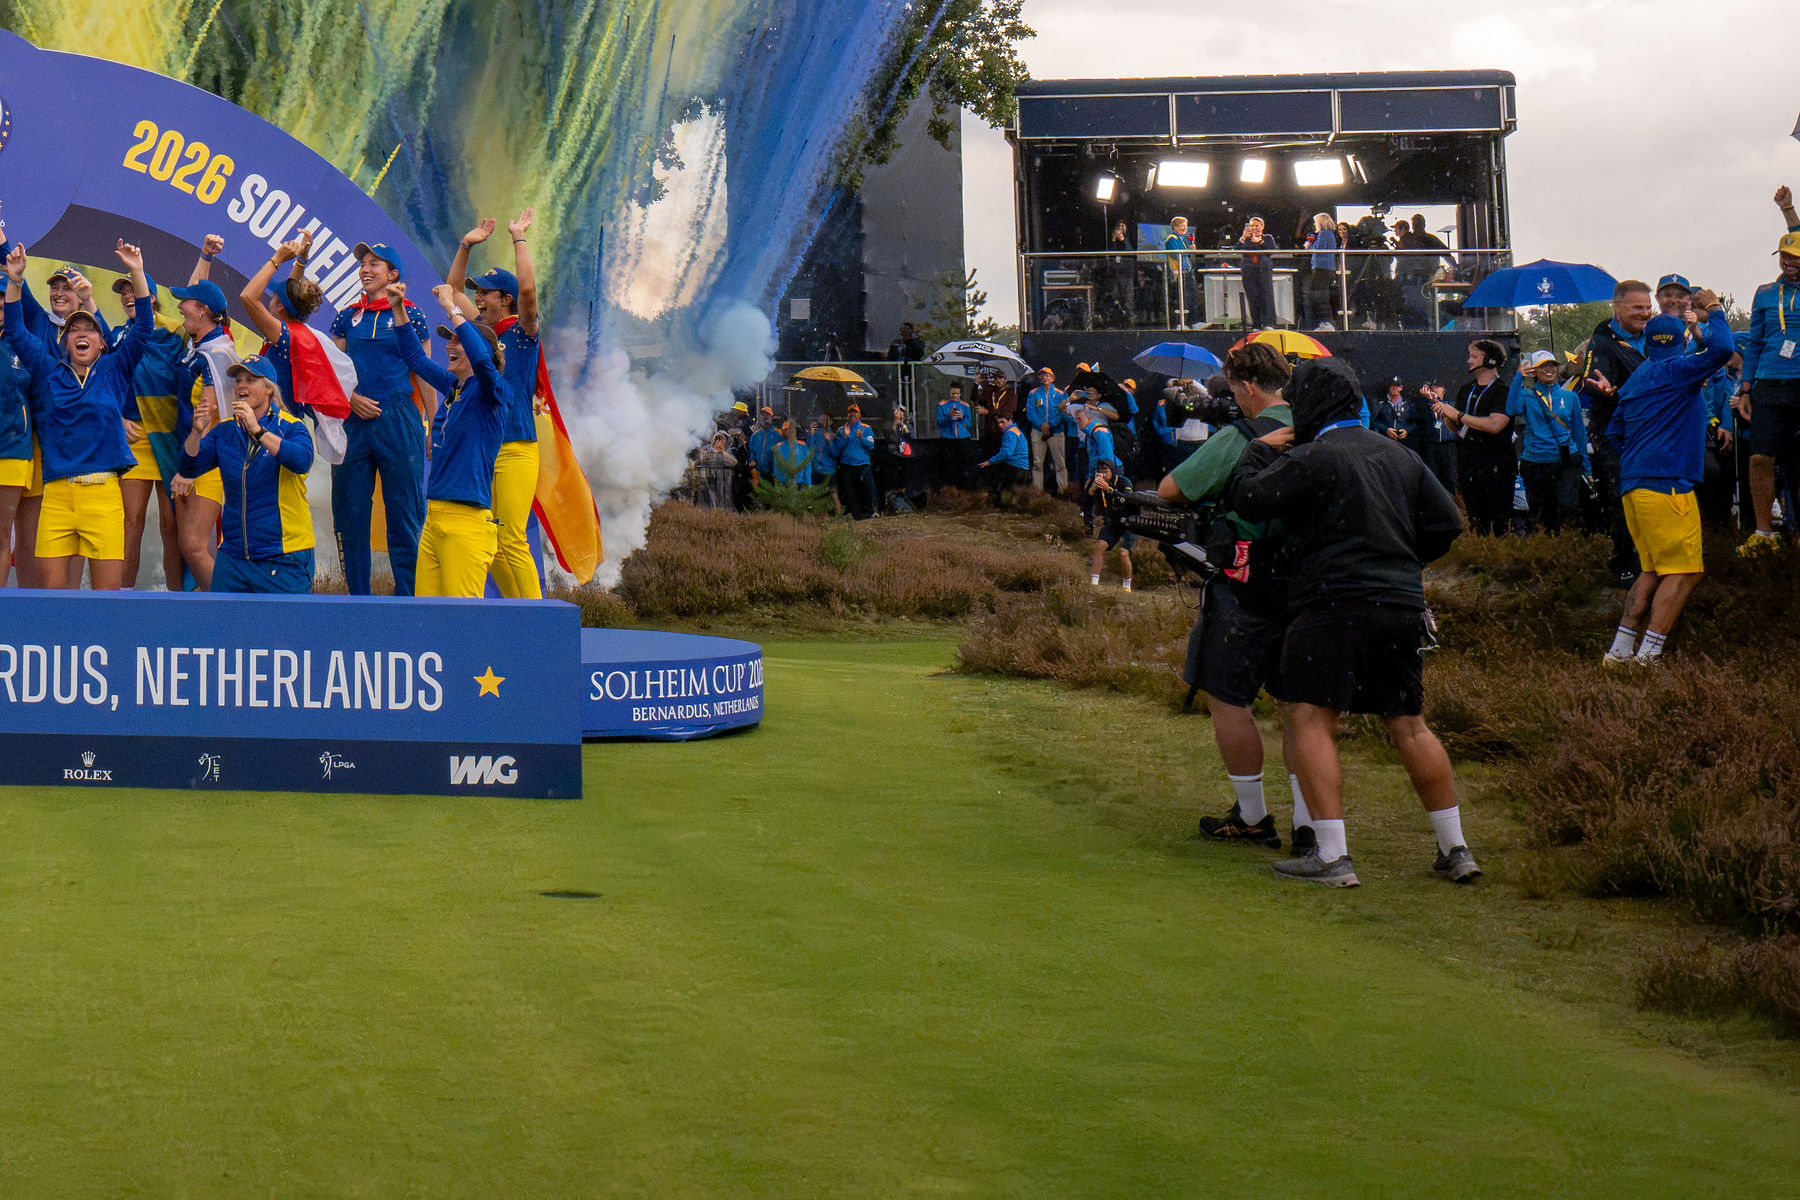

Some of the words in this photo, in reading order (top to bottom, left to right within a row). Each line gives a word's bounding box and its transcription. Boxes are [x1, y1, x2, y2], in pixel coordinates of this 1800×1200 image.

[123, 120, 235, 204] 2026
[136, 646, 443, 712] NETHERLANDS
[590, 668, 710, 701] SOLHEIM
[633, 703, 712, 722] BERNARDUS,
[713, 695, 759, 717] NETHERLANDS
[63, 768, 113, 781] ROLEX
